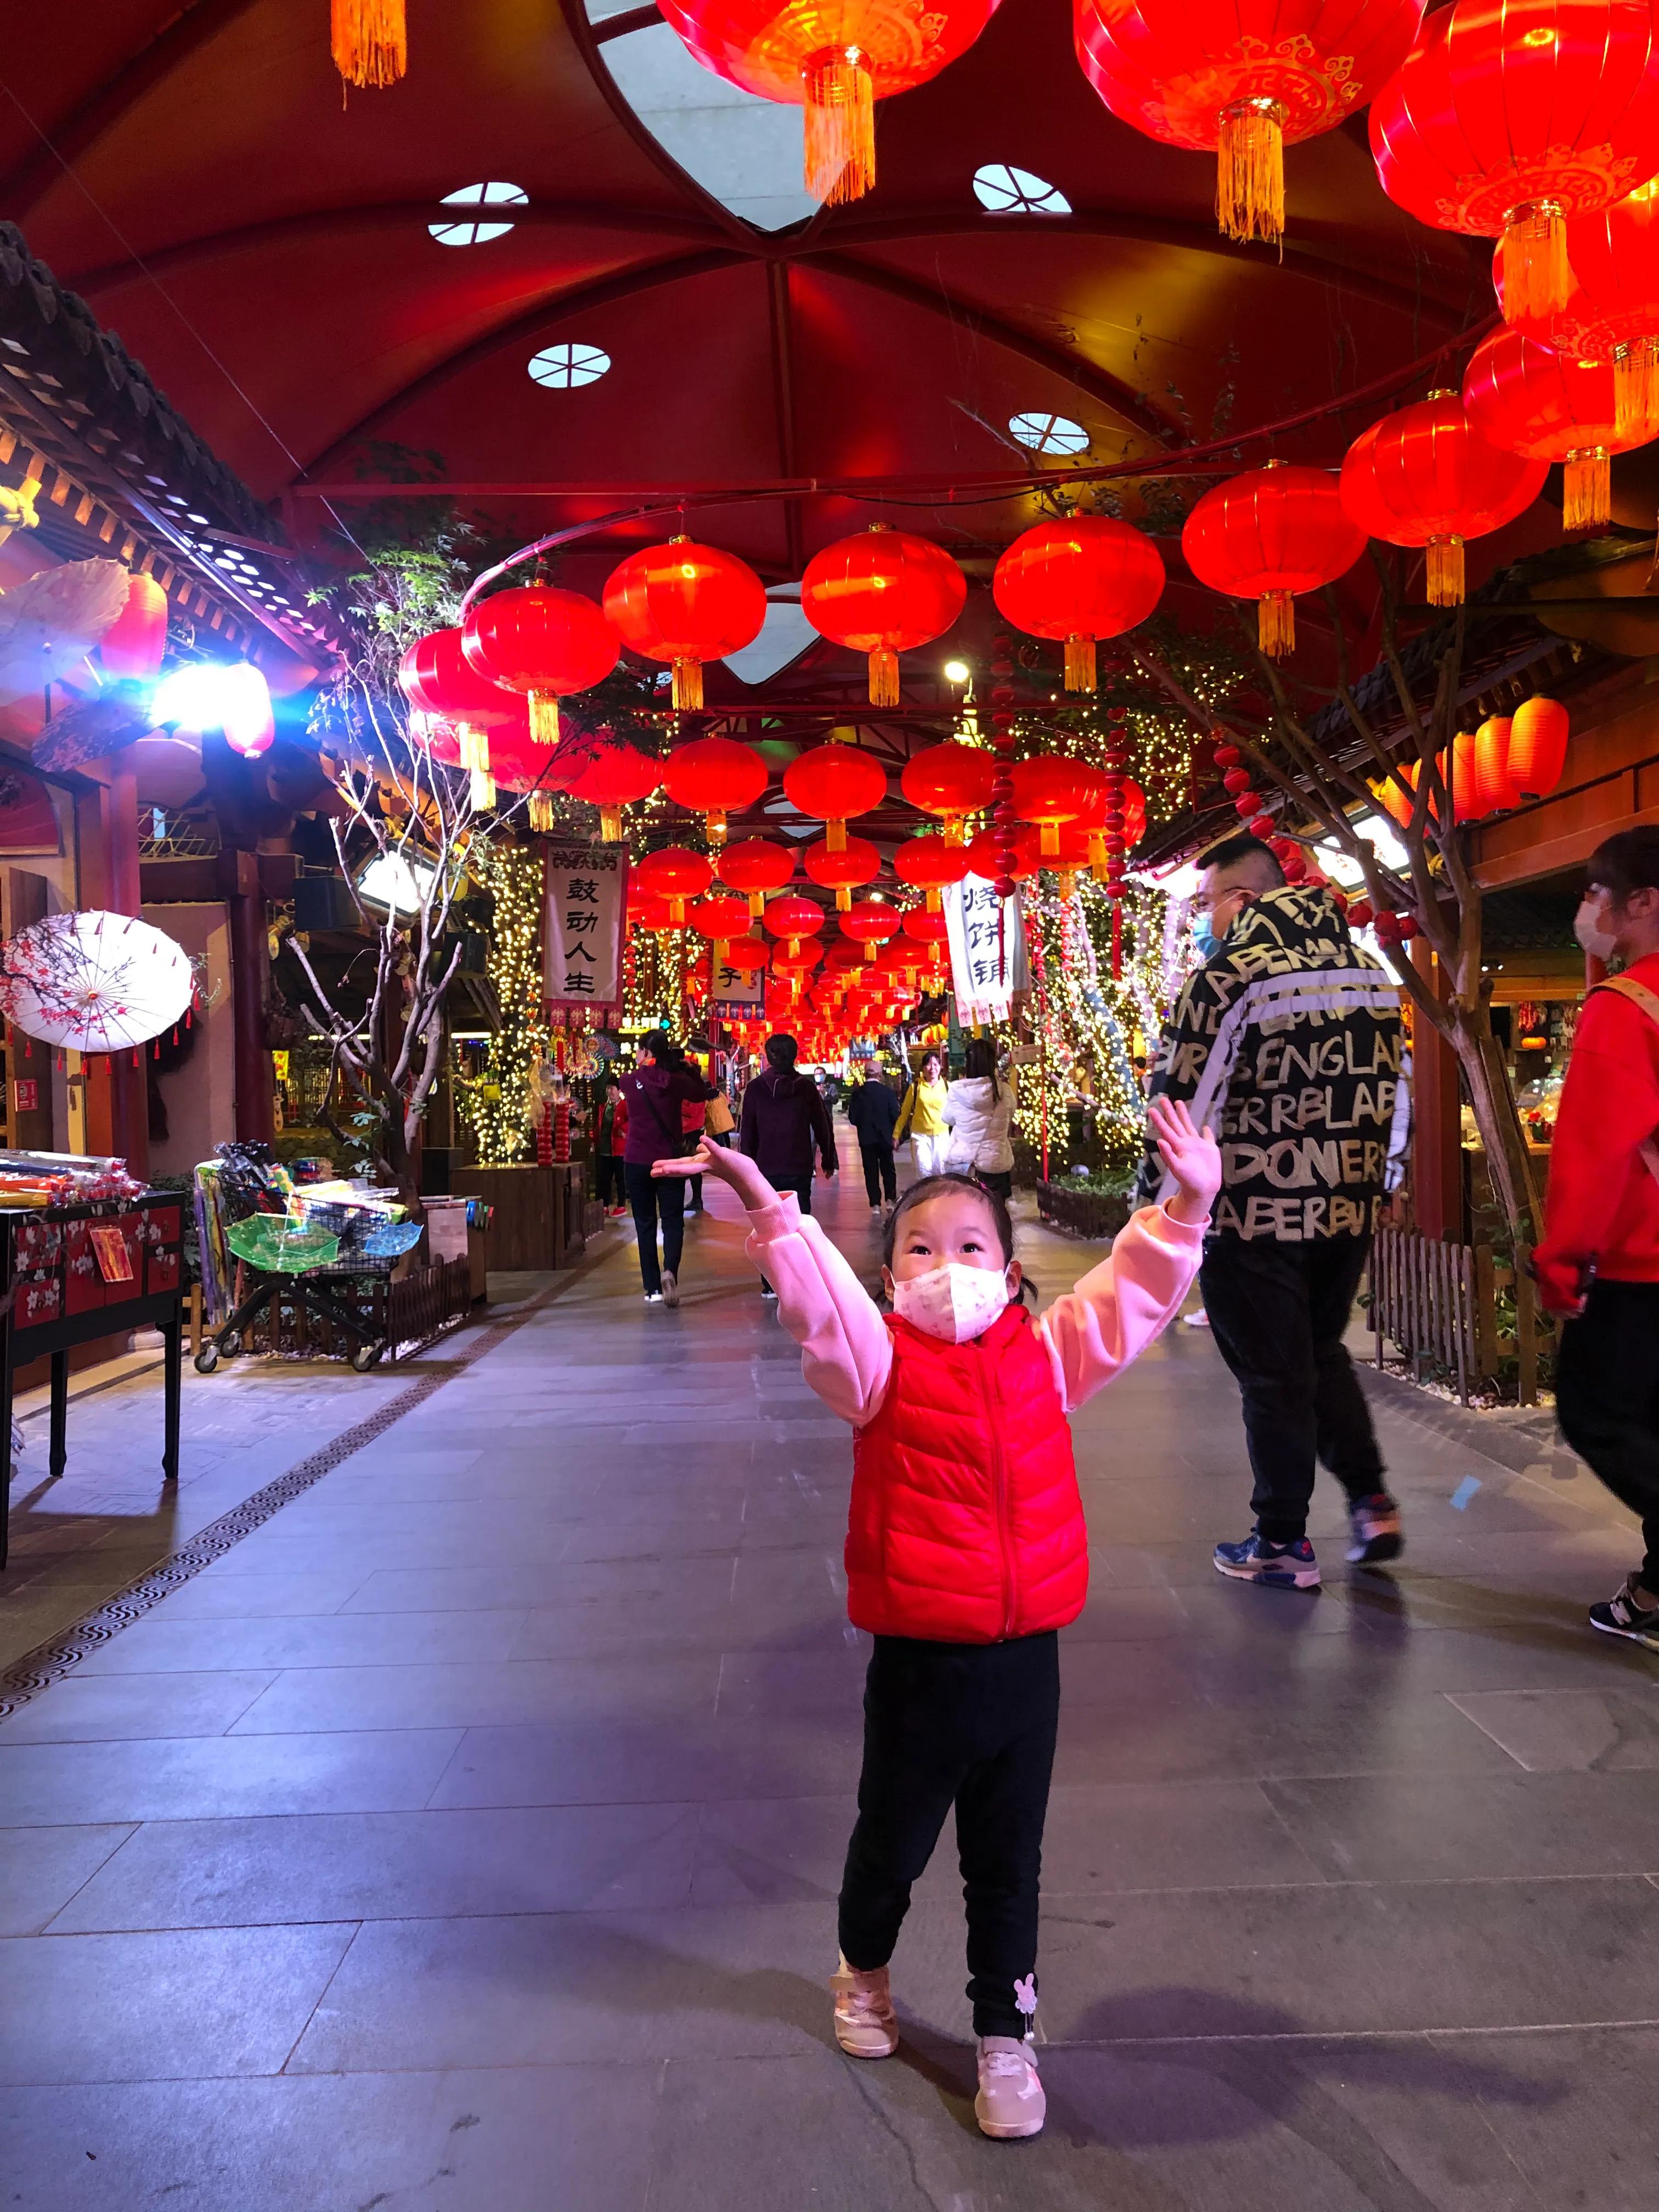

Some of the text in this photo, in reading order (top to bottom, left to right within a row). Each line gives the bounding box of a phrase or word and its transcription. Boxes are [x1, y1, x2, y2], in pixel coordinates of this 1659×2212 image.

[563, 878, 600, 994] 鼓动人生
[963, 887, 1010, 985] 烧饼铺
